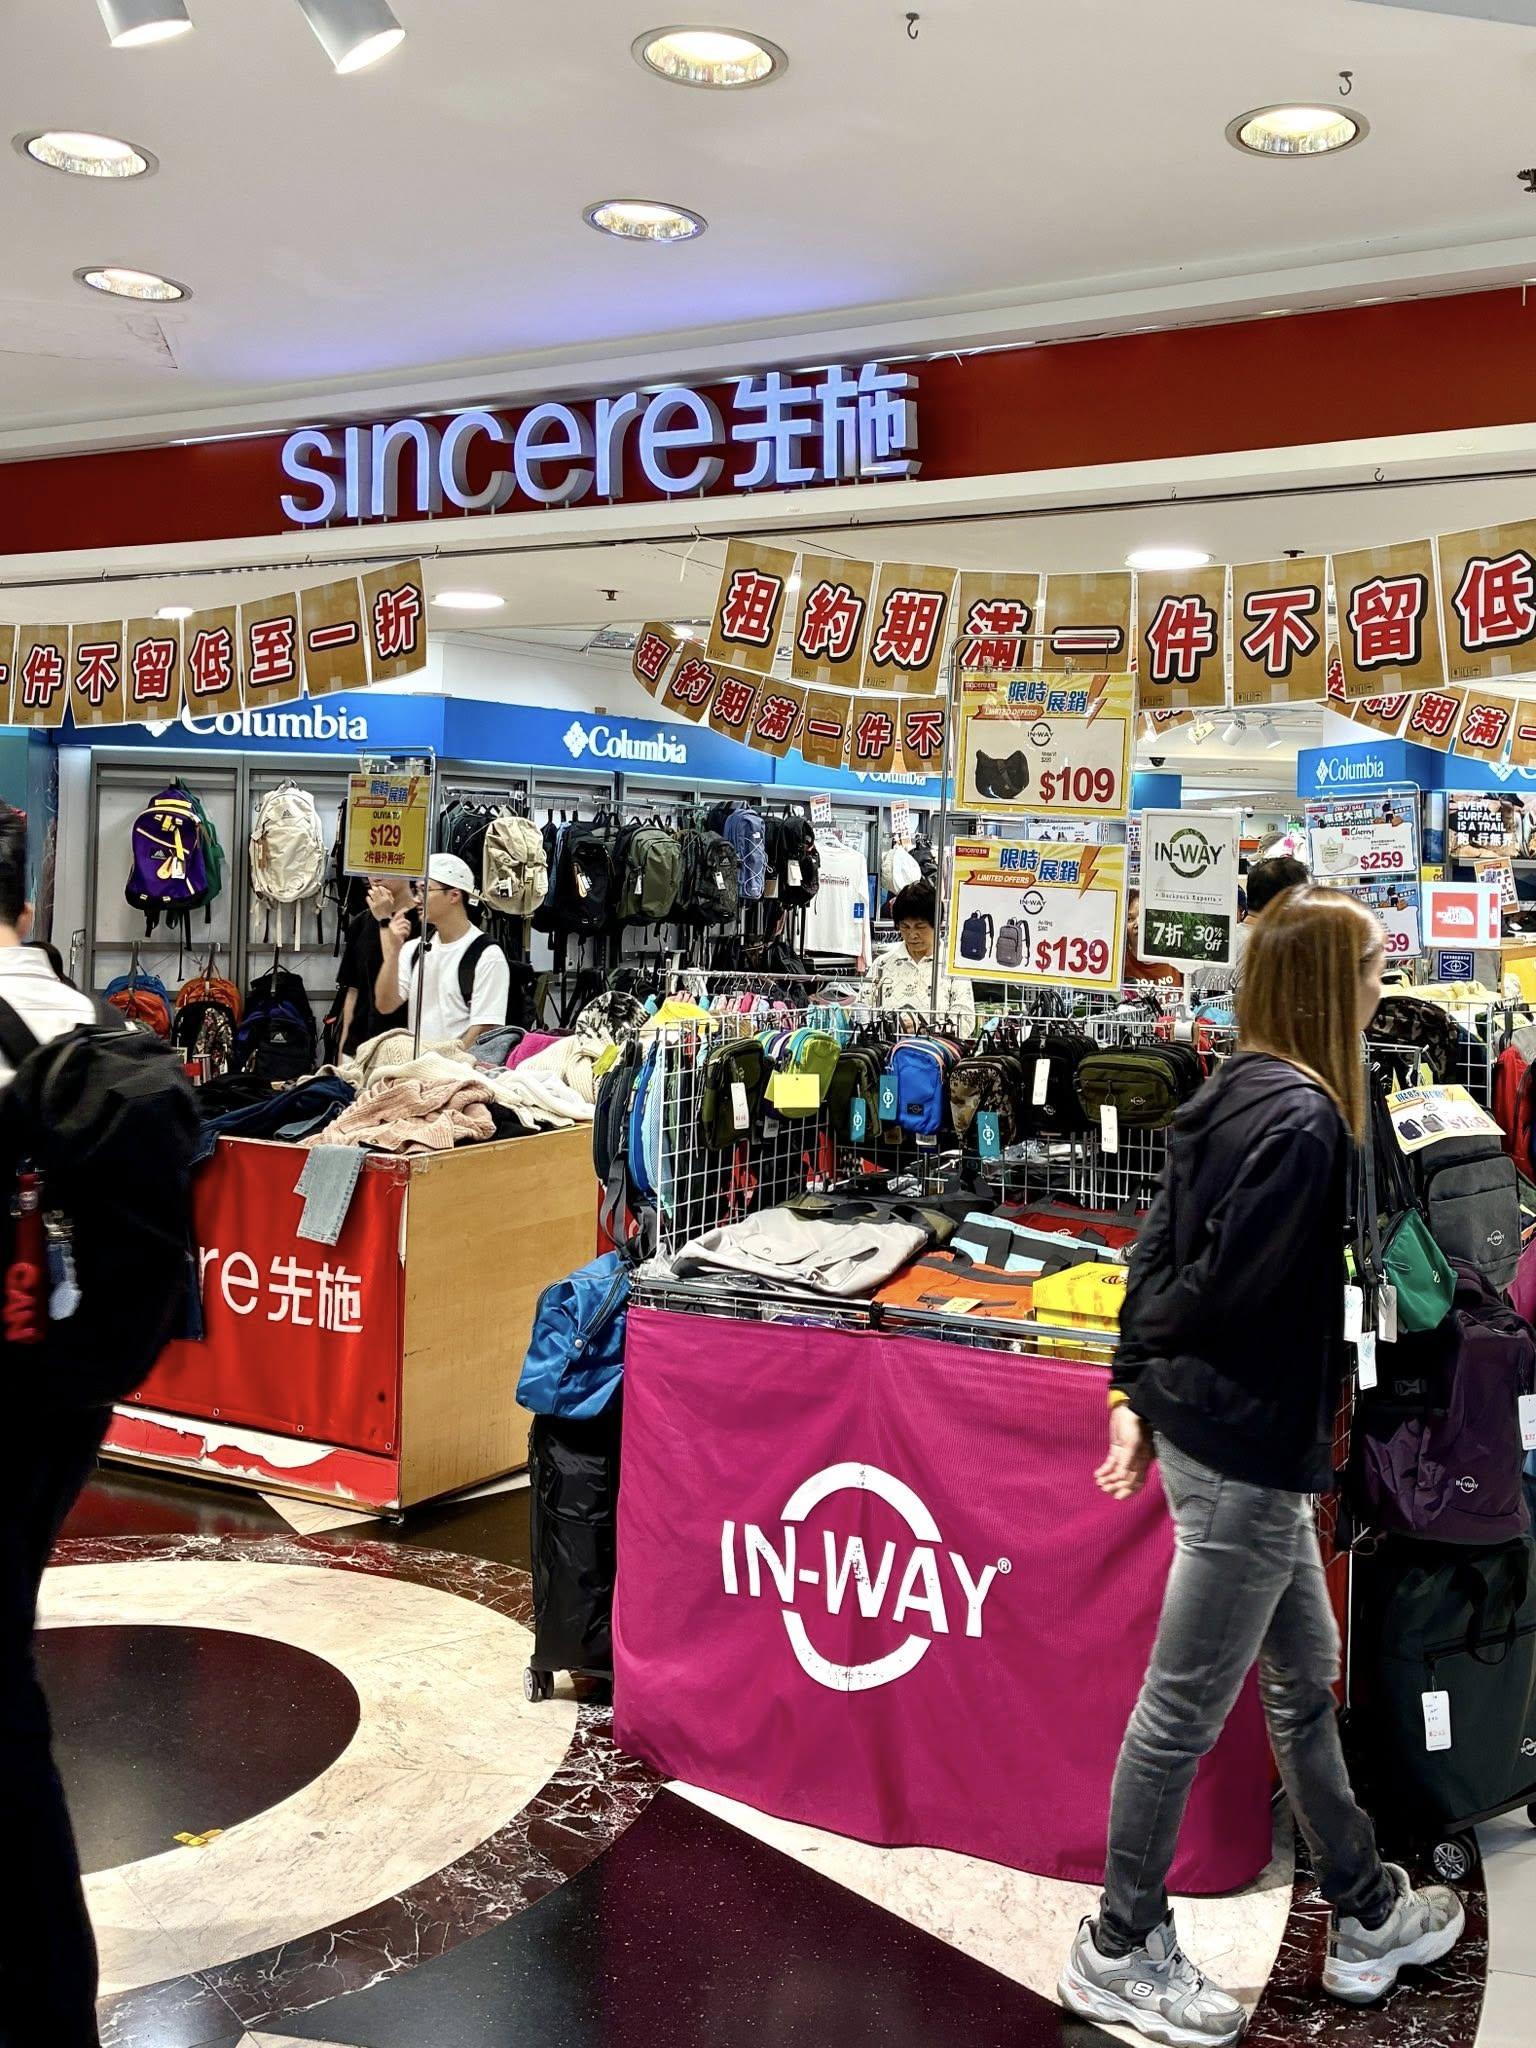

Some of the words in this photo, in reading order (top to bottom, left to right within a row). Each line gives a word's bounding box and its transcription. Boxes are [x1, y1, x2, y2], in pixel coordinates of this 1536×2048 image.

[281, 387, 723, 524] sincere
[731, 363, 921, 487] 先施
[720, 550, 1536, 684] 租約期滿一件不留低
[0, 583, 421, 705] 件不留低至一折
[1007, 681, 1088, 713] 限時展銷
[181, 704, 369, 740] Columbia
[588, 726, 687, 764] Columbia
[1328, 756, 1384, 782] Columbia
[1040, 767, 1115, 804] $109
[1458, 802, 1488, 811] EVERY
[1458, 812, 1502, 821] SURFACE
[370, 824, 401, 848] $129
[1458, 822, 1467, 831] IS
[1468, 822, 1476, 831] A
[1478, 822, 1505, 832] TRAIL
[1001, 848, 1079, 883] 限時展銷
[1154, 842, 1223, 865] IN-WAY
[1361, 851, 1404, 871] $259
[977, 874, 1003, 883] LIMITED
[1004, 876, 1030, 884] OFFERS
[1152, 922, 1184, 948] 7折
[1193, 925, 1224, 943] 30%
[1035, 936, 1109, 975] $139
[267, 1255, 364, 1333] 先施
